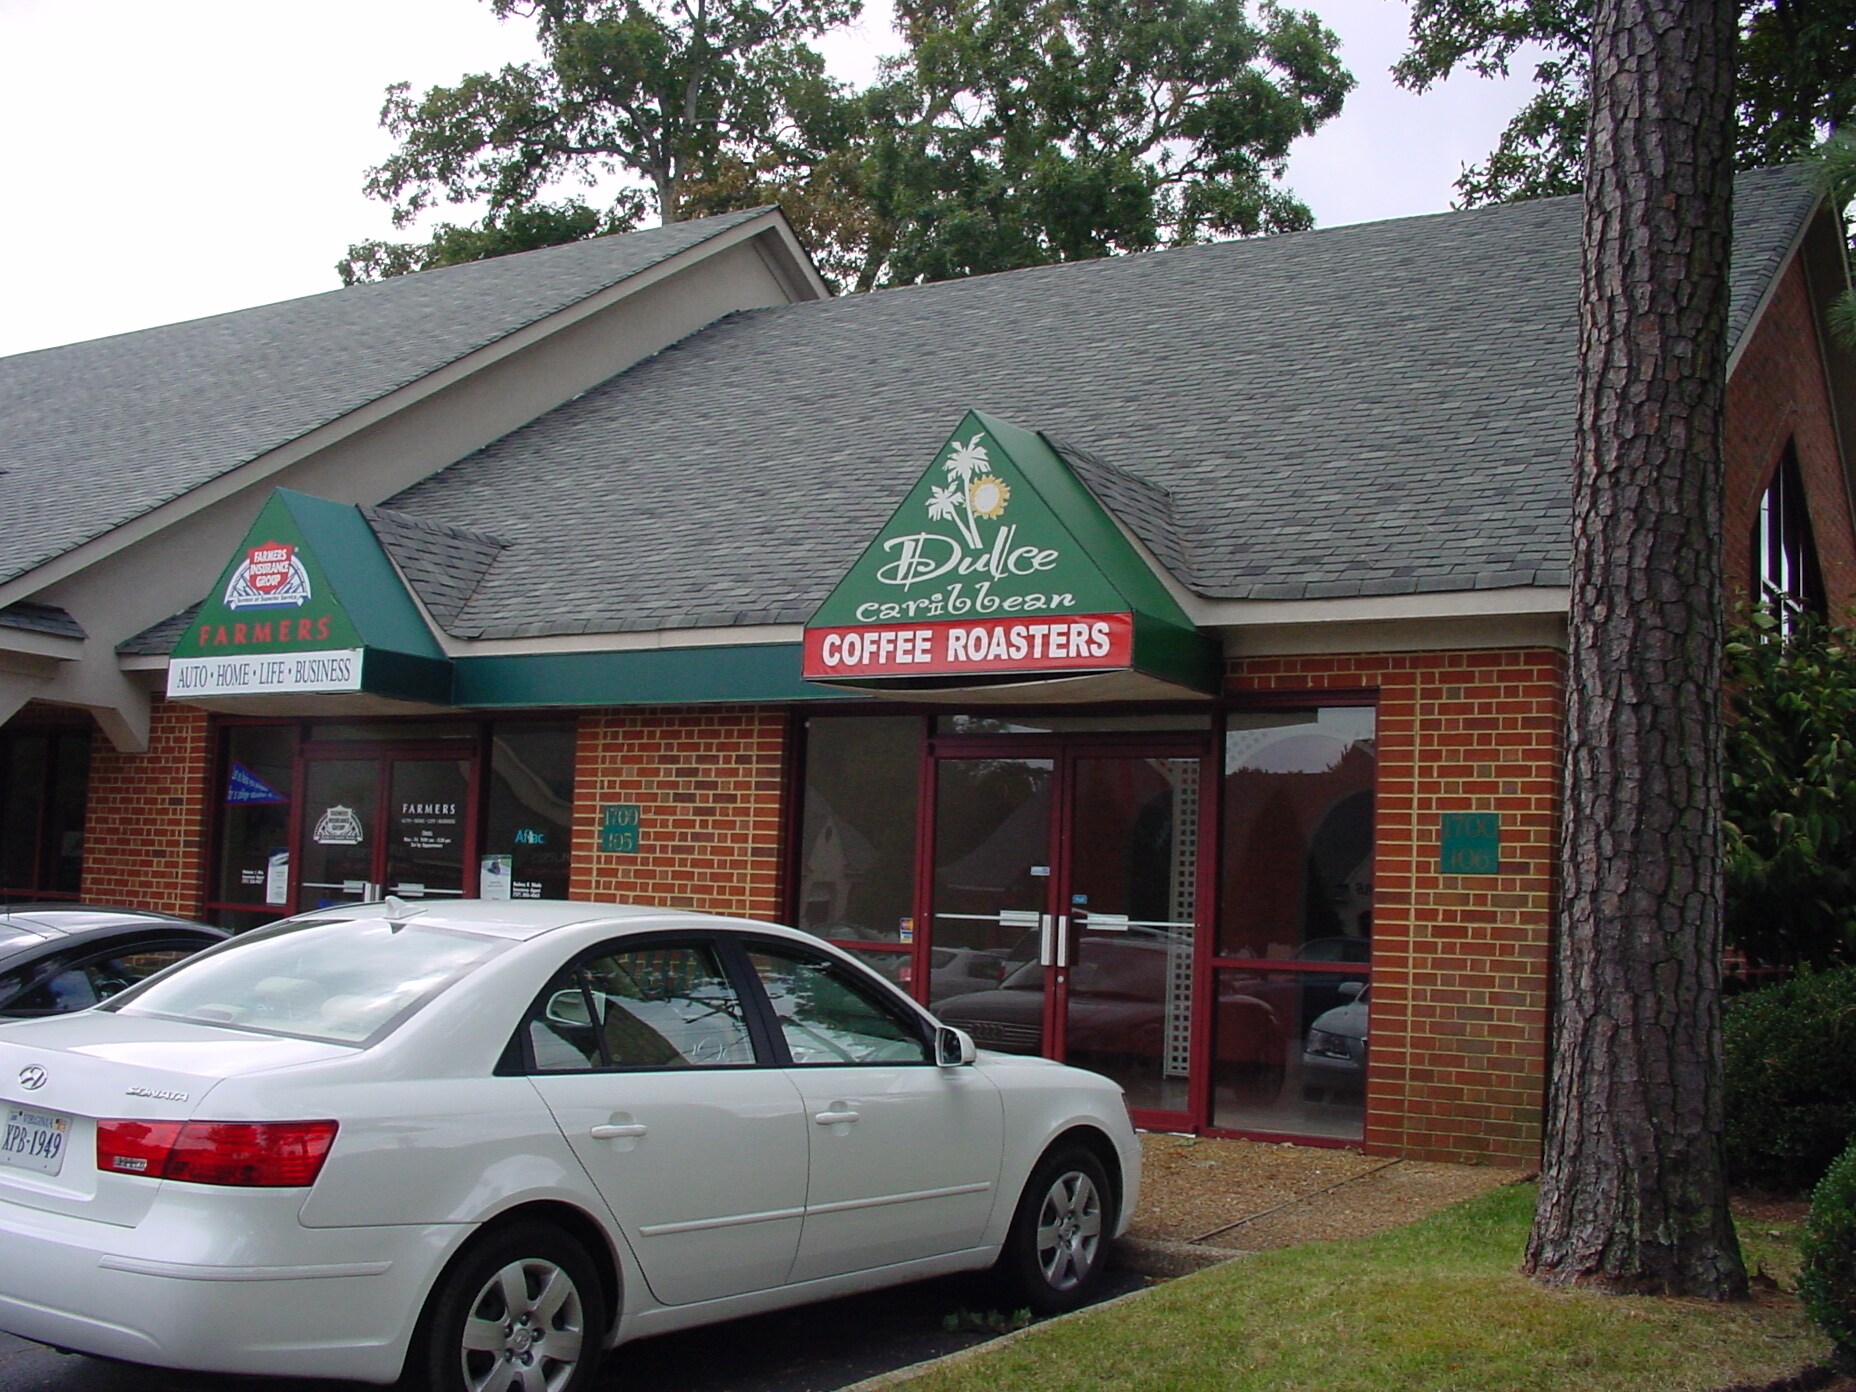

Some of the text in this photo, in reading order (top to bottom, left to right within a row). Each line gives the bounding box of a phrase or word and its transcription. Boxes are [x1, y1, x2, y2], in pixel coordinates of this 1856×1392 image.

[250, 561, 289, 575] INSURANCE
[254, 548, 287, 562] FARMERS
[877, 524, 1059, 592] Dulce
[255, 574, 282, 588] GROUP
[856, 582, 1075, 622] caribbean
[198, 616, 330, 646] FARMERS
[822, 621, 1111, 667] COFFEE ROASTERS
[177, 658, 352, 688] AUTO HOME LIFE BUSINESS
[402, 803, 456, 815] FARMERS
[125, 1086, 189, 1103] SONATA
[2, 1123, 62, 1159] XPB-1949
